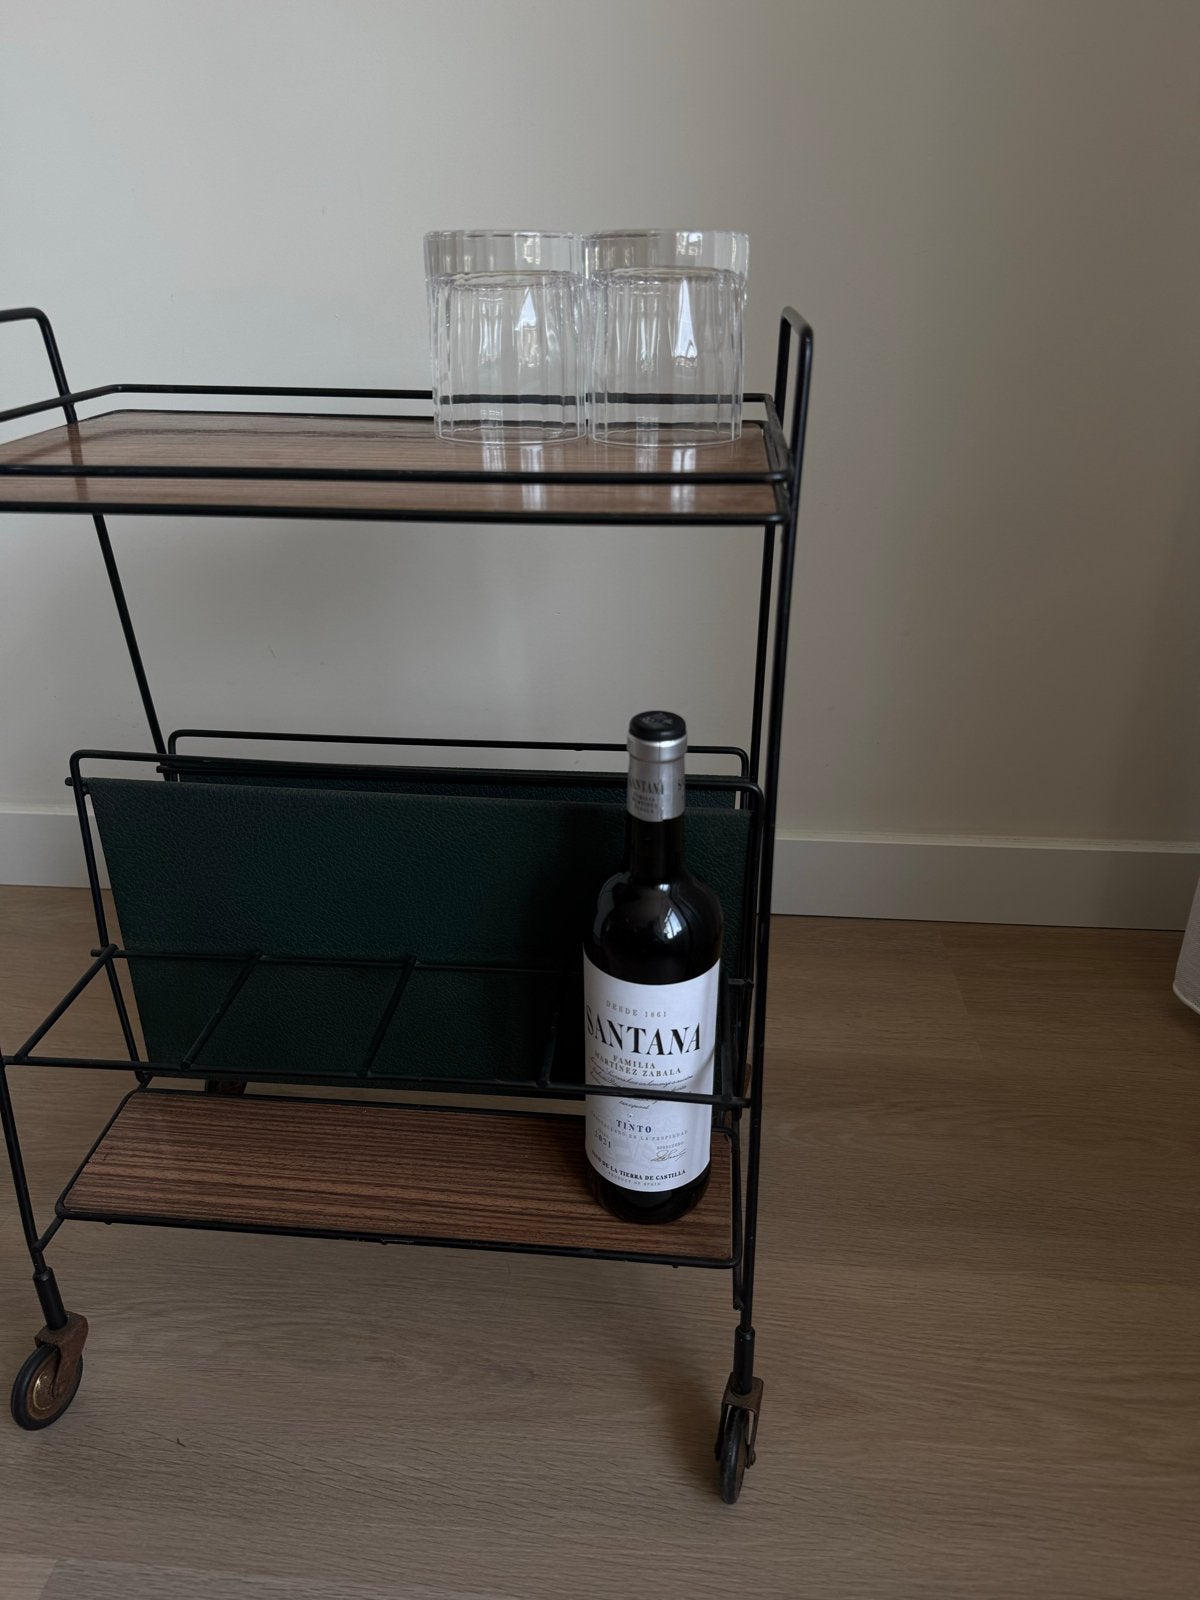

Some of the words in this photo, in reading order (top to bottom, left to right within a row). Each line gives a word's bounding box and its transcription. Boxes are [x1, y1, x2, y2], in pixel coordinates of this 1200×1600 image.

[585, 1005, 700, 1056] SANTANA
[613, 1055, 655, 1069] FAMILIA
[642, 1067, 681, 1077] ZABALA
[615, 1119, 652, 1134] TINTO
[610, 1165, 617, 1173] LA
[619, 1170, 643, 1180] TIERRA
